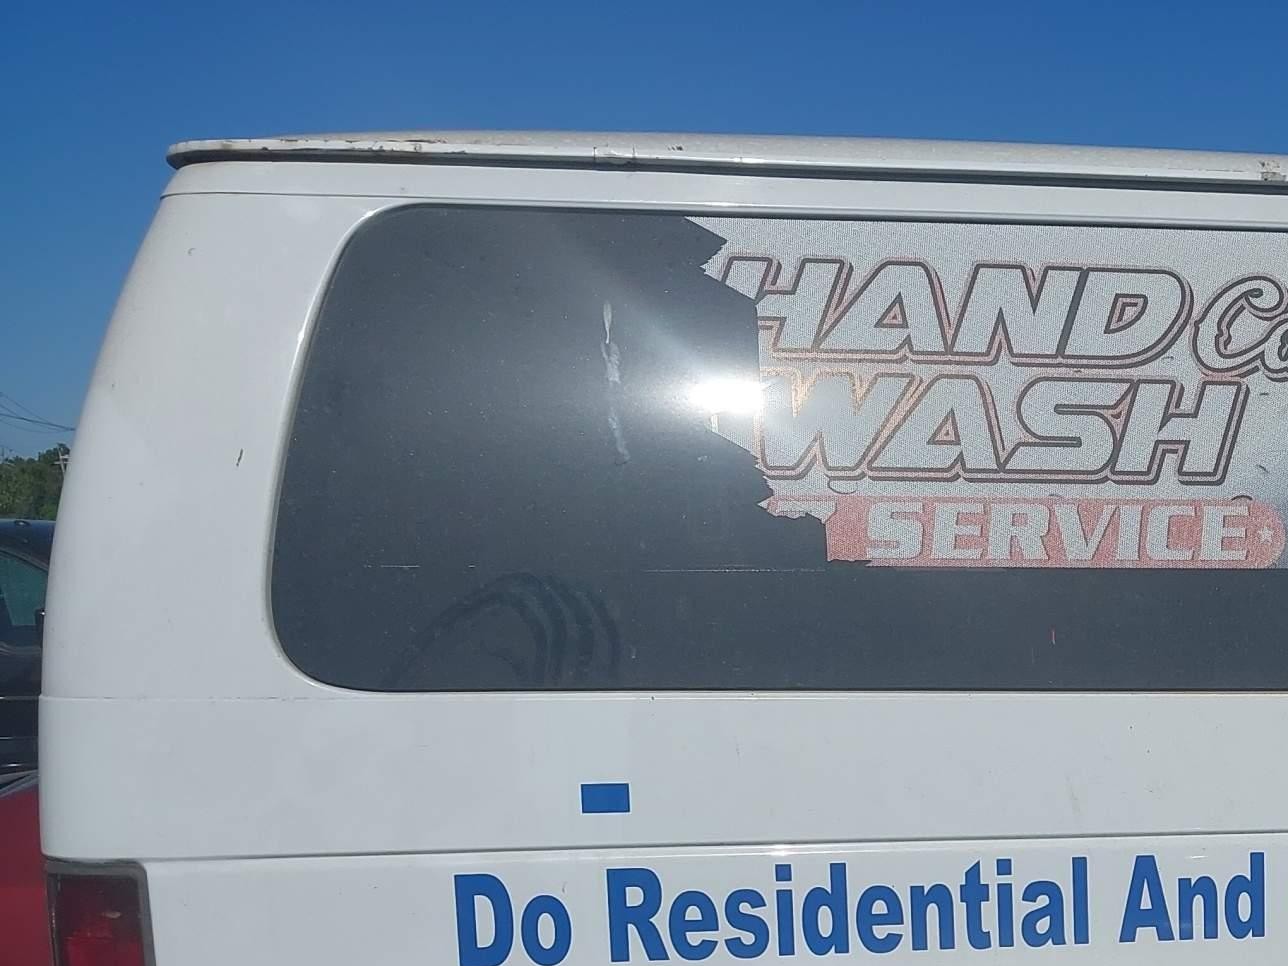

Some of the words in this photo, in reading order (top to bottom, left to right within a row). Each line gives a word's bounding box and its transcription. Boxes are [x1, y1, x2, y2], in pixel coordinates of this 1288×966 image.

[720, 254, 1194, 368] HAND
[756, 367, 1250, 485] WASH
[865, 501, 1252, 562] SERVICE
[606, 855, 1091, 963] Residential
[1118, 851, 1266, 944] And
